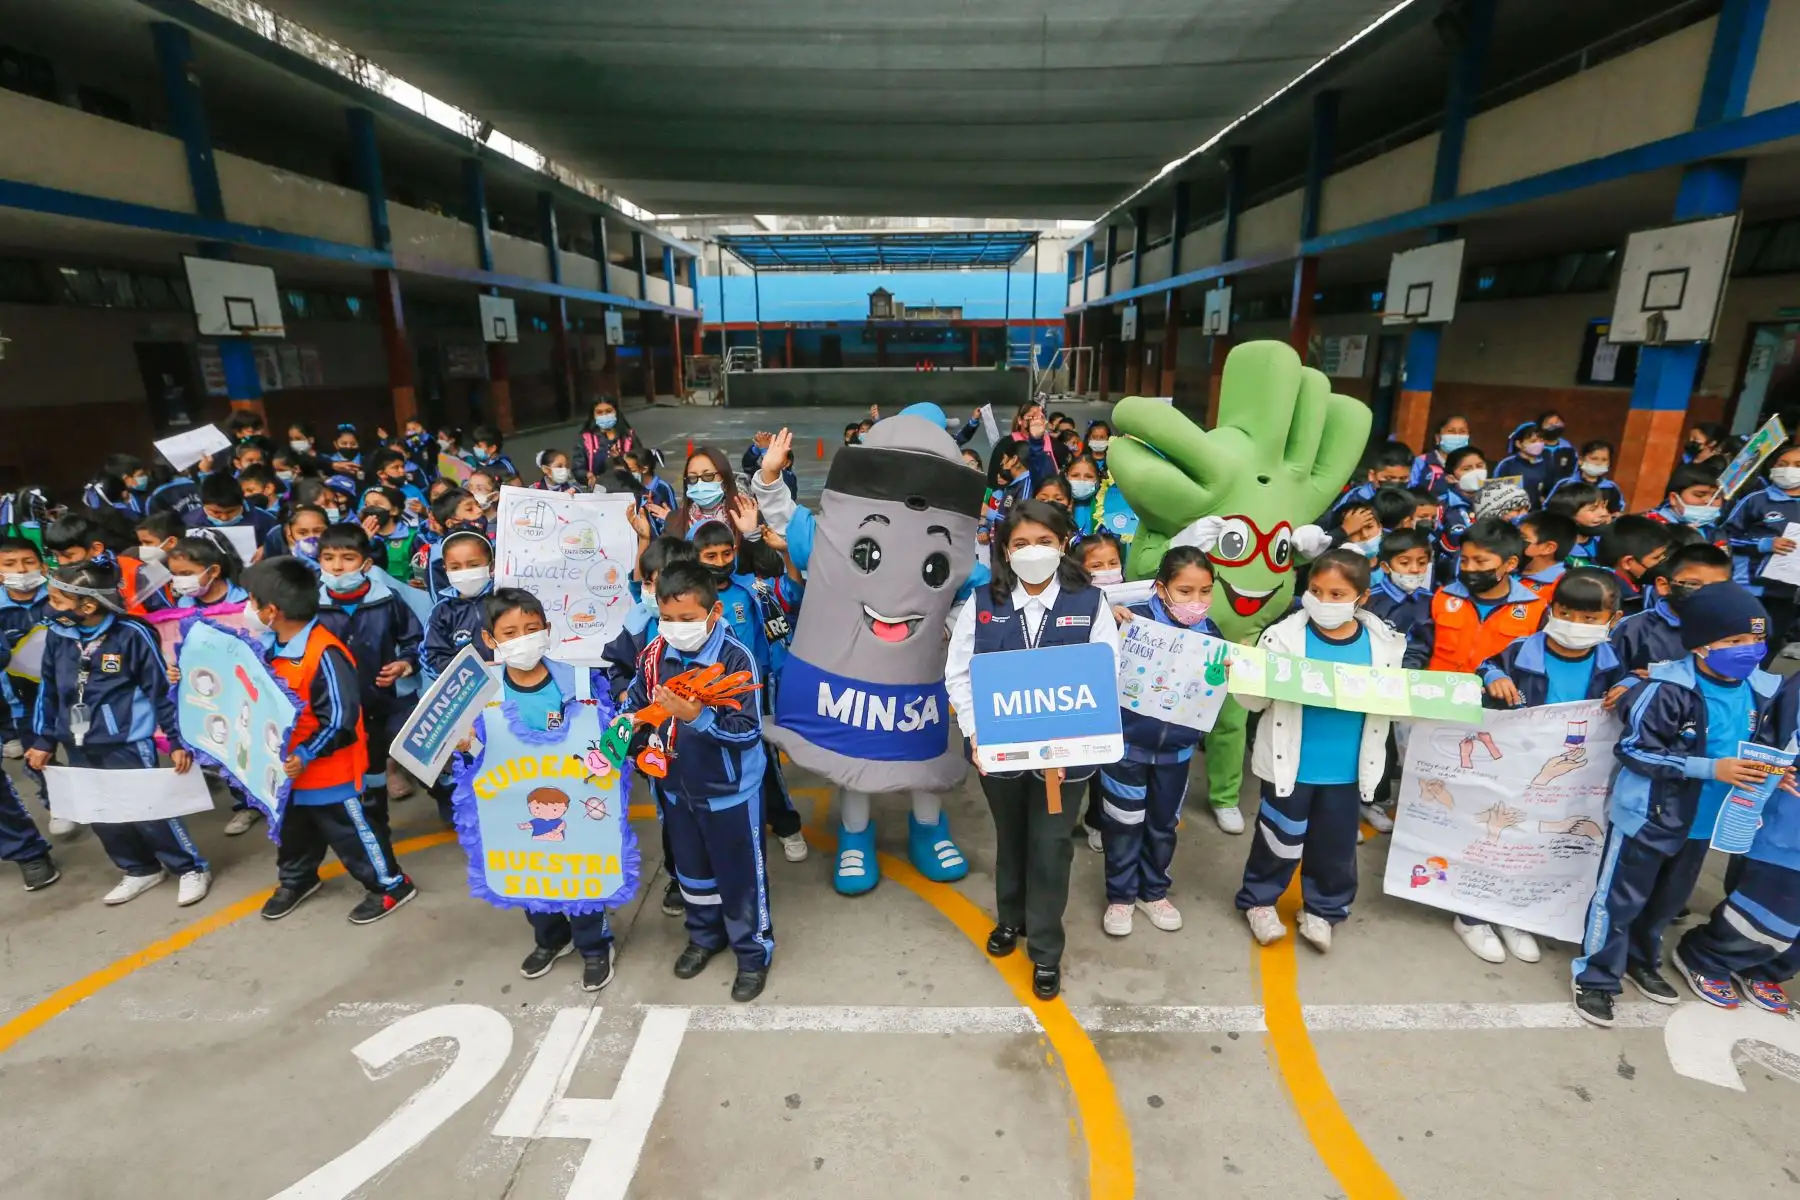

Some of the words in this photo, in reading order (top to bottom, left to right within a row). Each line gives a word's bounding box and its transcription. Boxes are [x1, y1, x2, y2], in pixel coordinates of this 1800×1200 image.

[411, 667, 474, 748] MINSA
[817, 681, 940, 733] MINSA
[992, 684, 1098, 718] MINSA
[488, 850, 621, 875] NUESTRA
[505, 875, 602, 898] SALUD
[266, 1003, 691, 1200] 24
